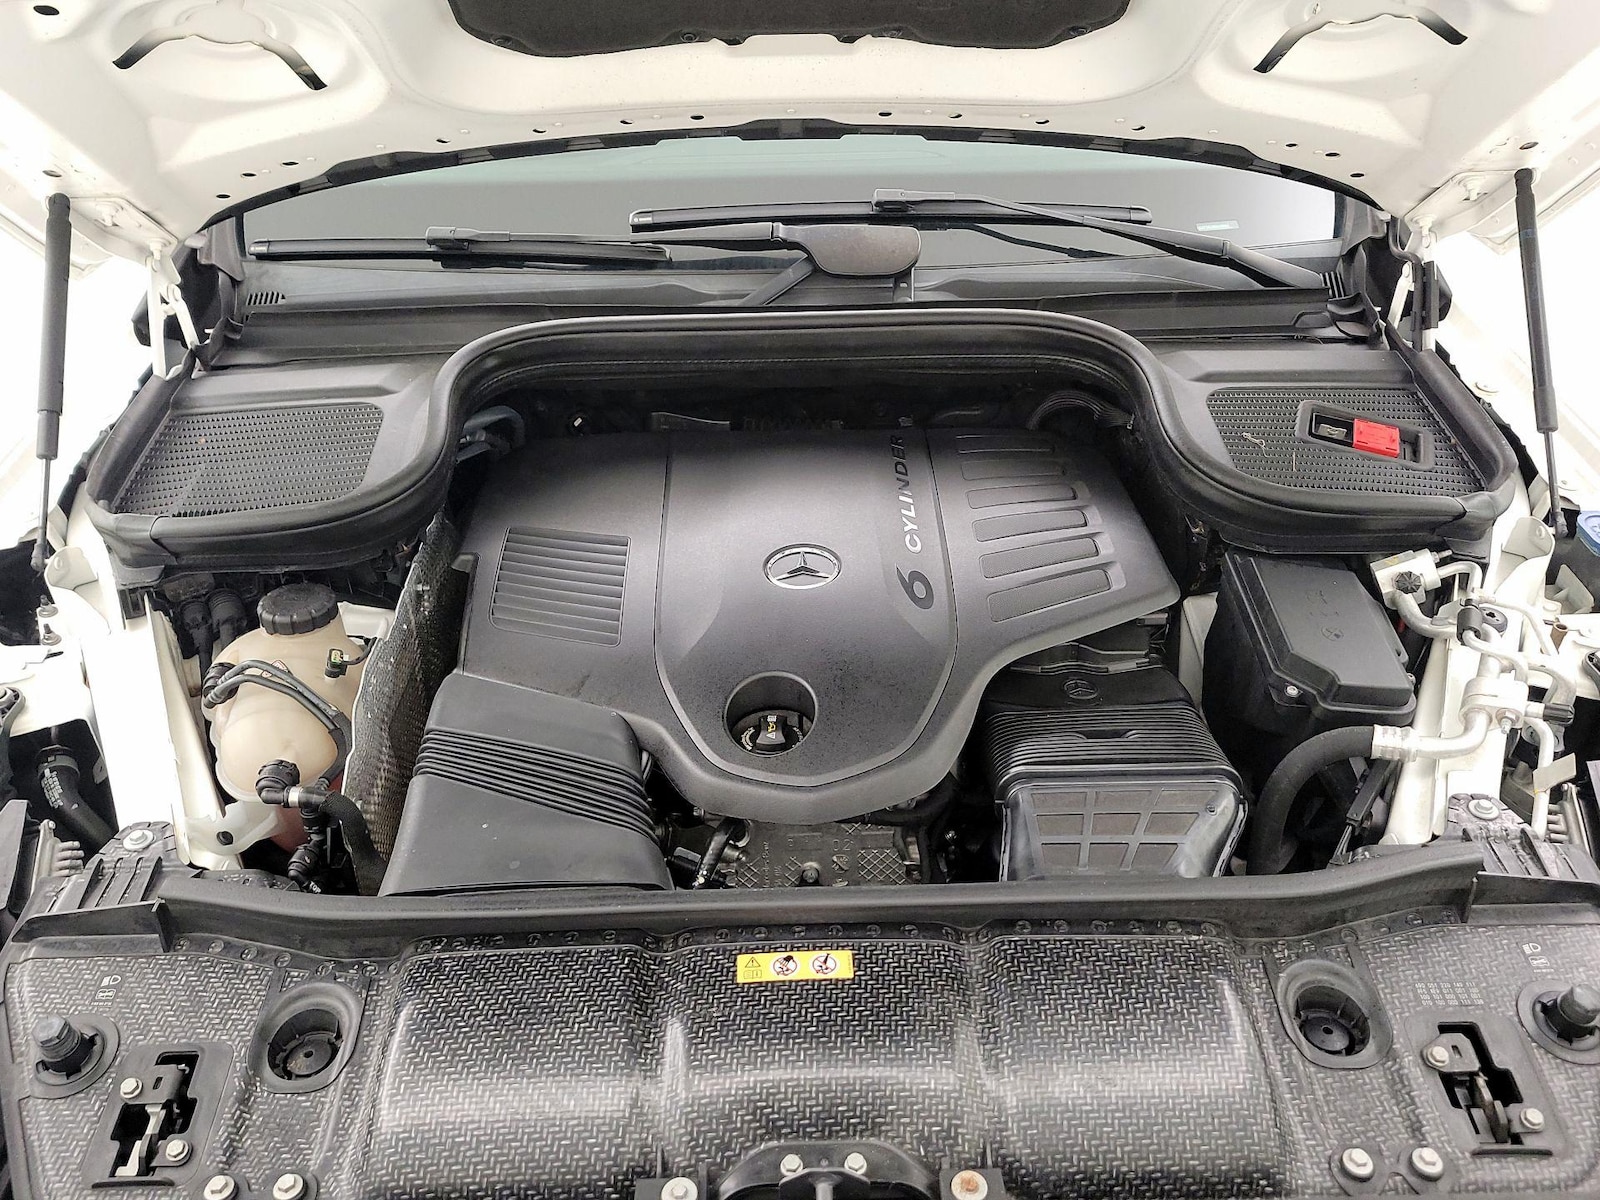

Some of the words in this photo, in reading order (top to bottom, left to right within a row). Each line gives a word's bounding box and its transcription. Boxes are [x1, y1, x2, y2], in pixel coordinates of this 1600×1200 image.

[890, 435, 922, 554] CYLINDER
[895, 563, 934, 609] 6
[310, 881, 321, 893] TOP
